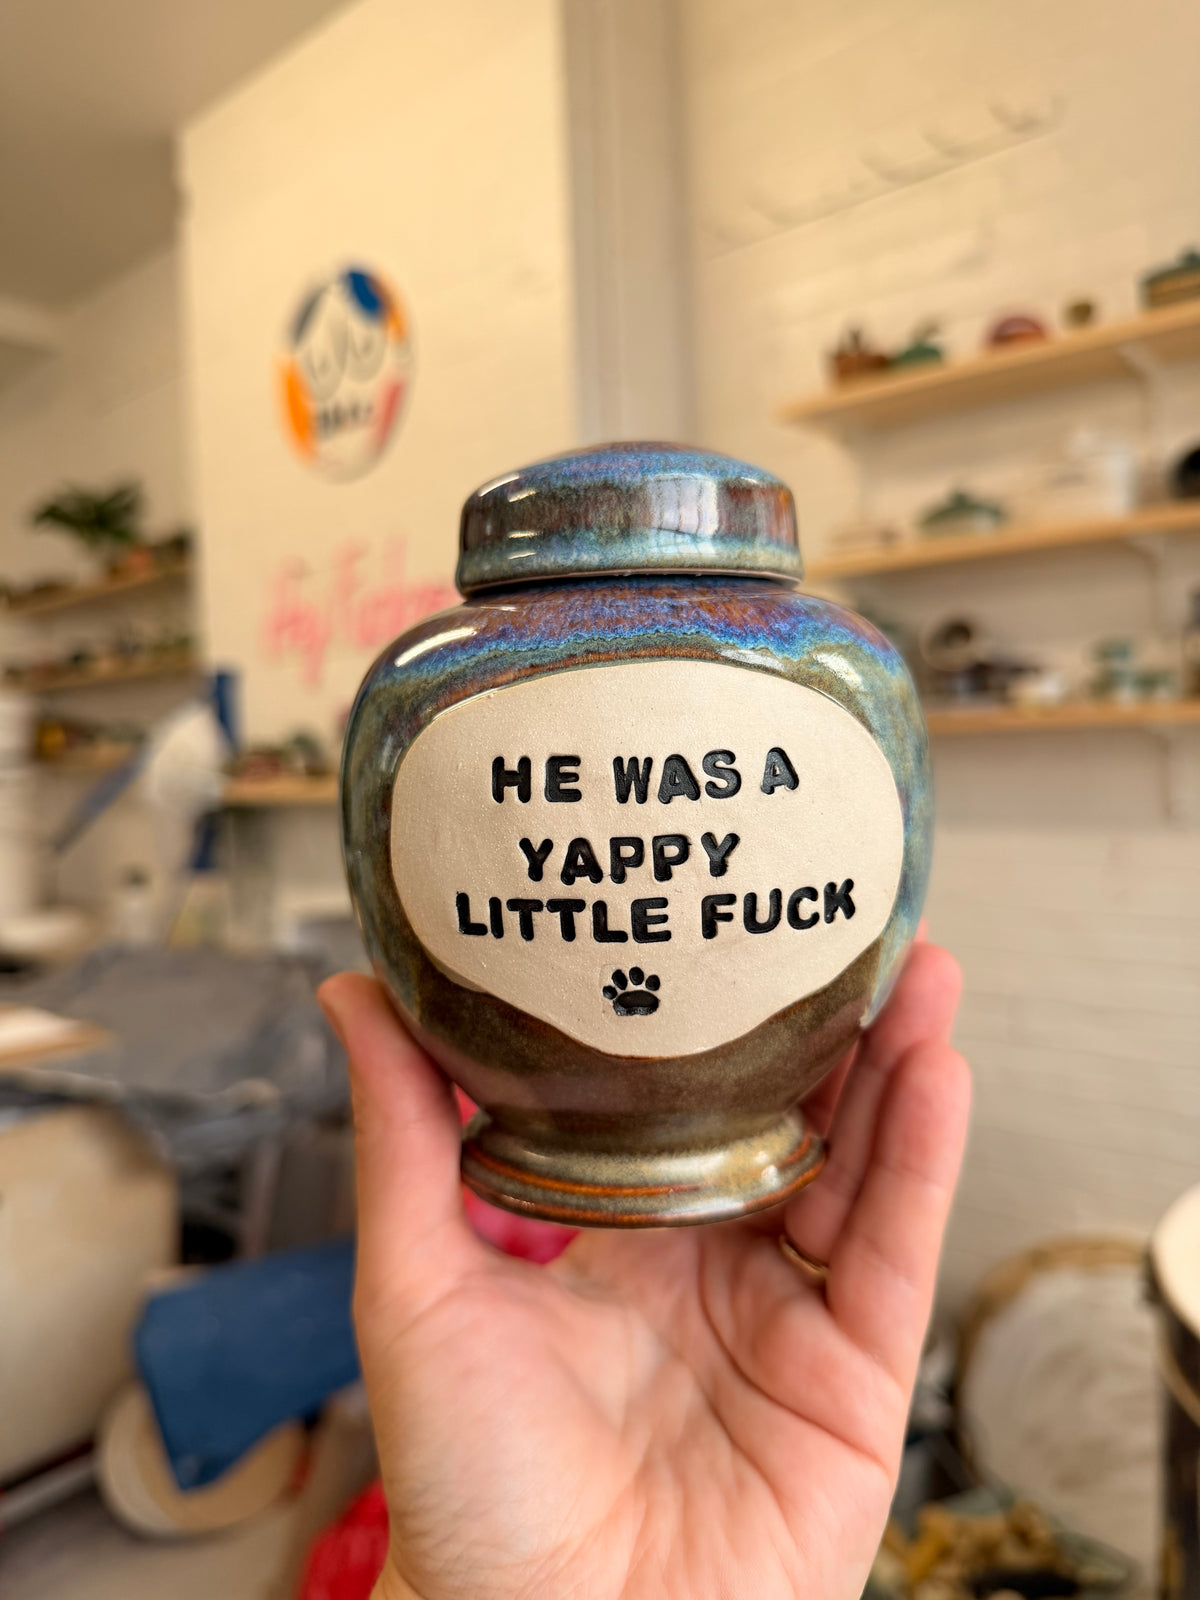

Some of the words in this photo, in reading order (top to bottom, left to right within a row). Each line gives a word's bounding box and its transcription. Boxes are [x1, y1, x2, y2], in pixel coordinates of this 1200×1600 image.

[491, 754, 583, 805] HE
[612, 749, 742, 805] WAS
[760, 746, 800, 796] A
[518, 831, 741, 886] YAPPY
[456, 891, 673, 944] LITTLE
[701, 878, 857, 940] FUCK
